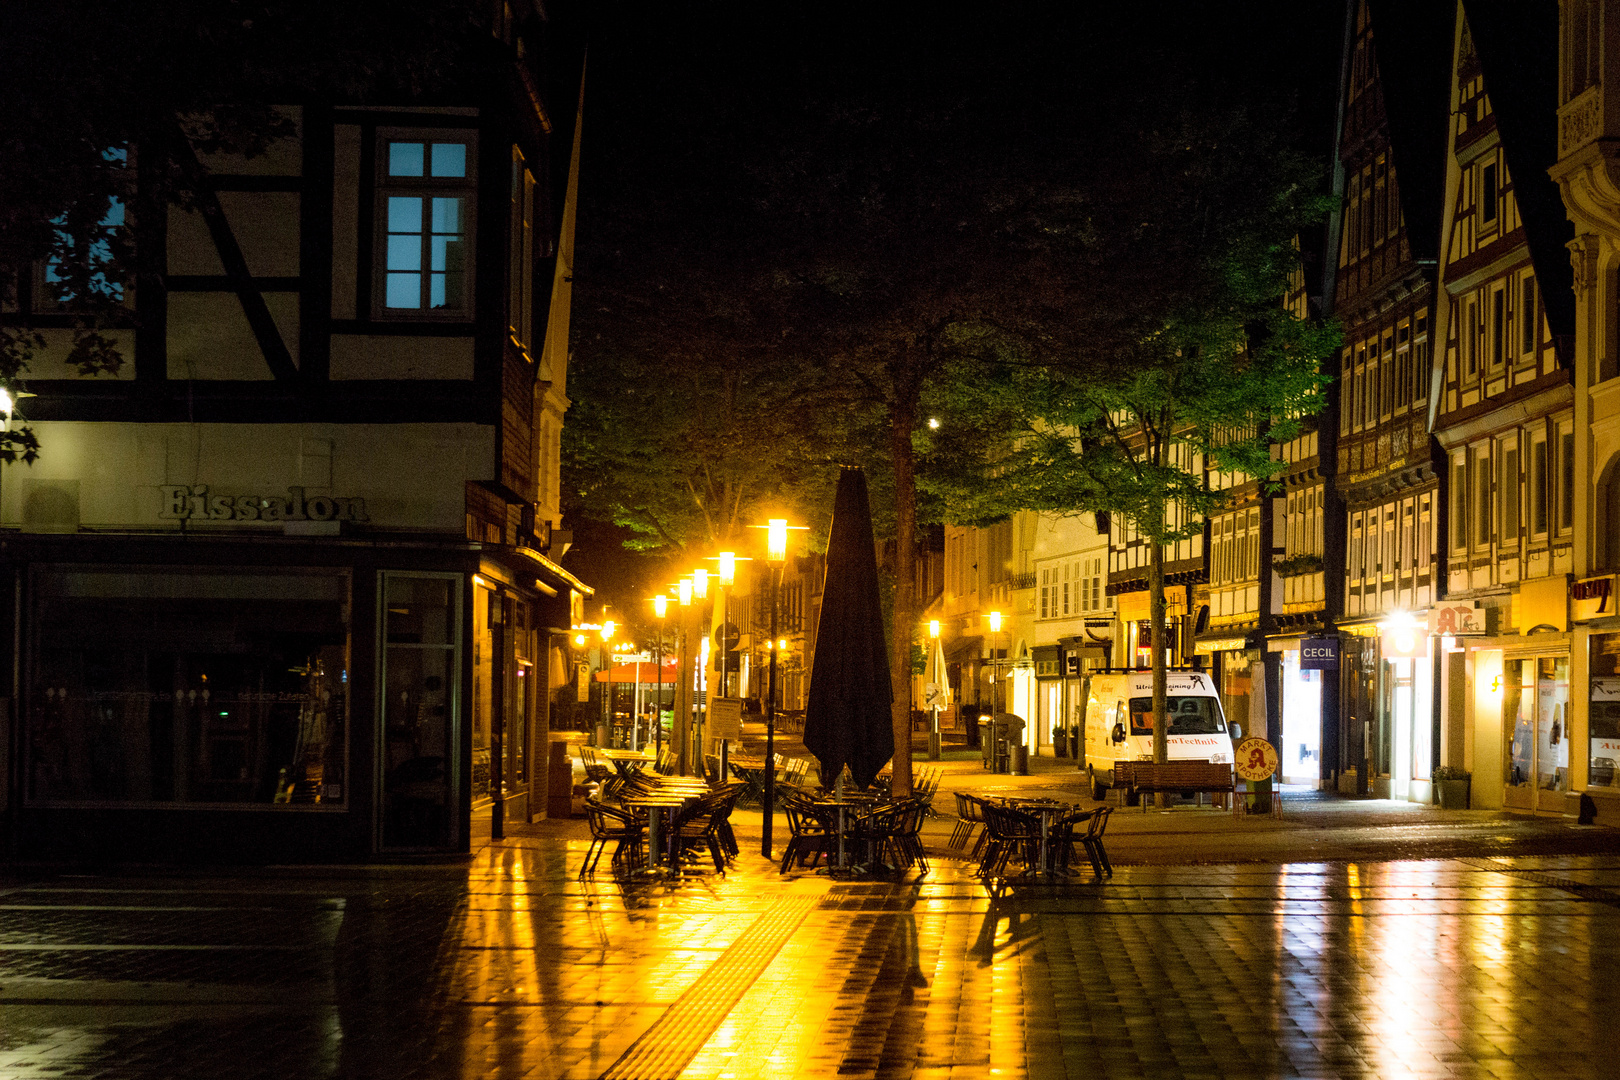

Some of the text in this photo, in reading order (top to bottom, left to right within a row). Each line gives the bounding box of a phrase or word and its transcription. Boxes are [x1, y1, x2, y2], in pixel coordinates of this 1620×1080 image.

[158, 484, 370, 521] Eissalon
[1303, 648, 1335, 657] CECIL
[1240, 740, 1272, 753] MARKT
[1237, 760, 1276, 779] APOTHEKE
